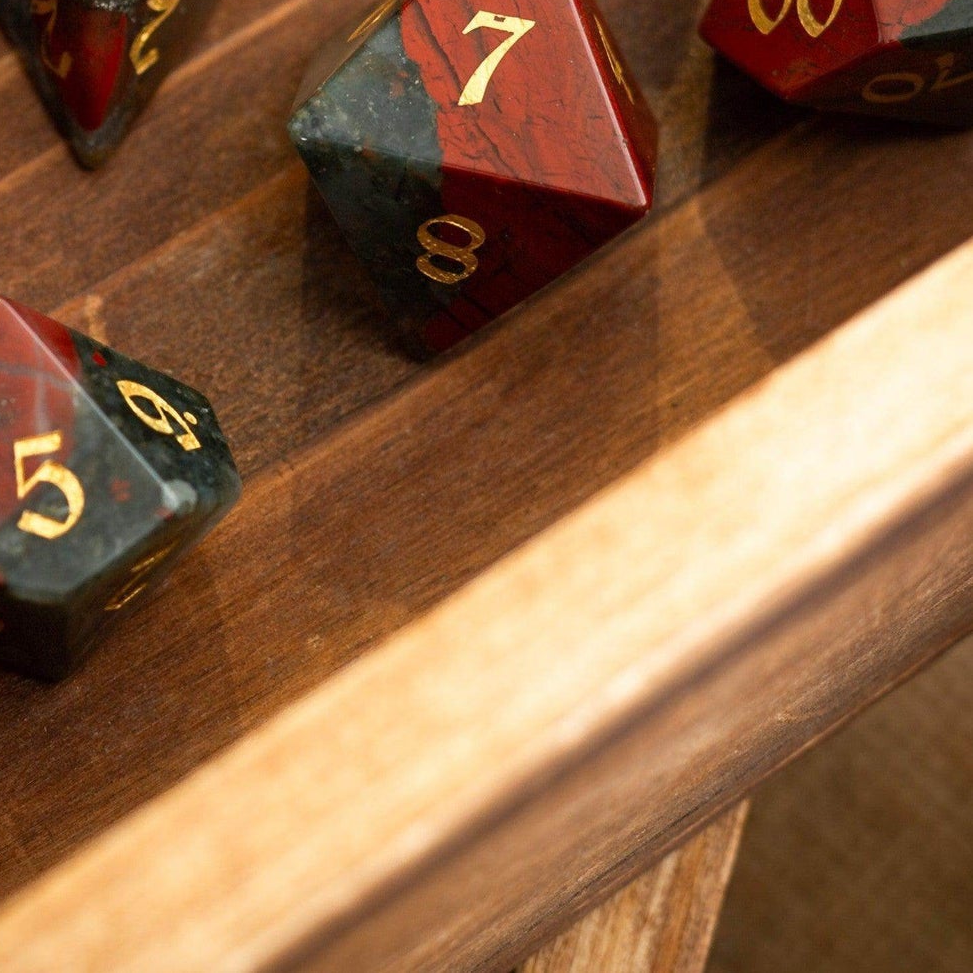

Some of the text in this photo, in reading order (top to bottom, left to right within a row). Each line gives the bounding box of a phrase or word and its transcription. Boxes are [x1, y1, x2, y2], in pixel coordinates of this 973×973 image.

[457, 10, 536, 106] 7
[416, 214, 486, 285] 8
[13, 430, 85, 539] 5
